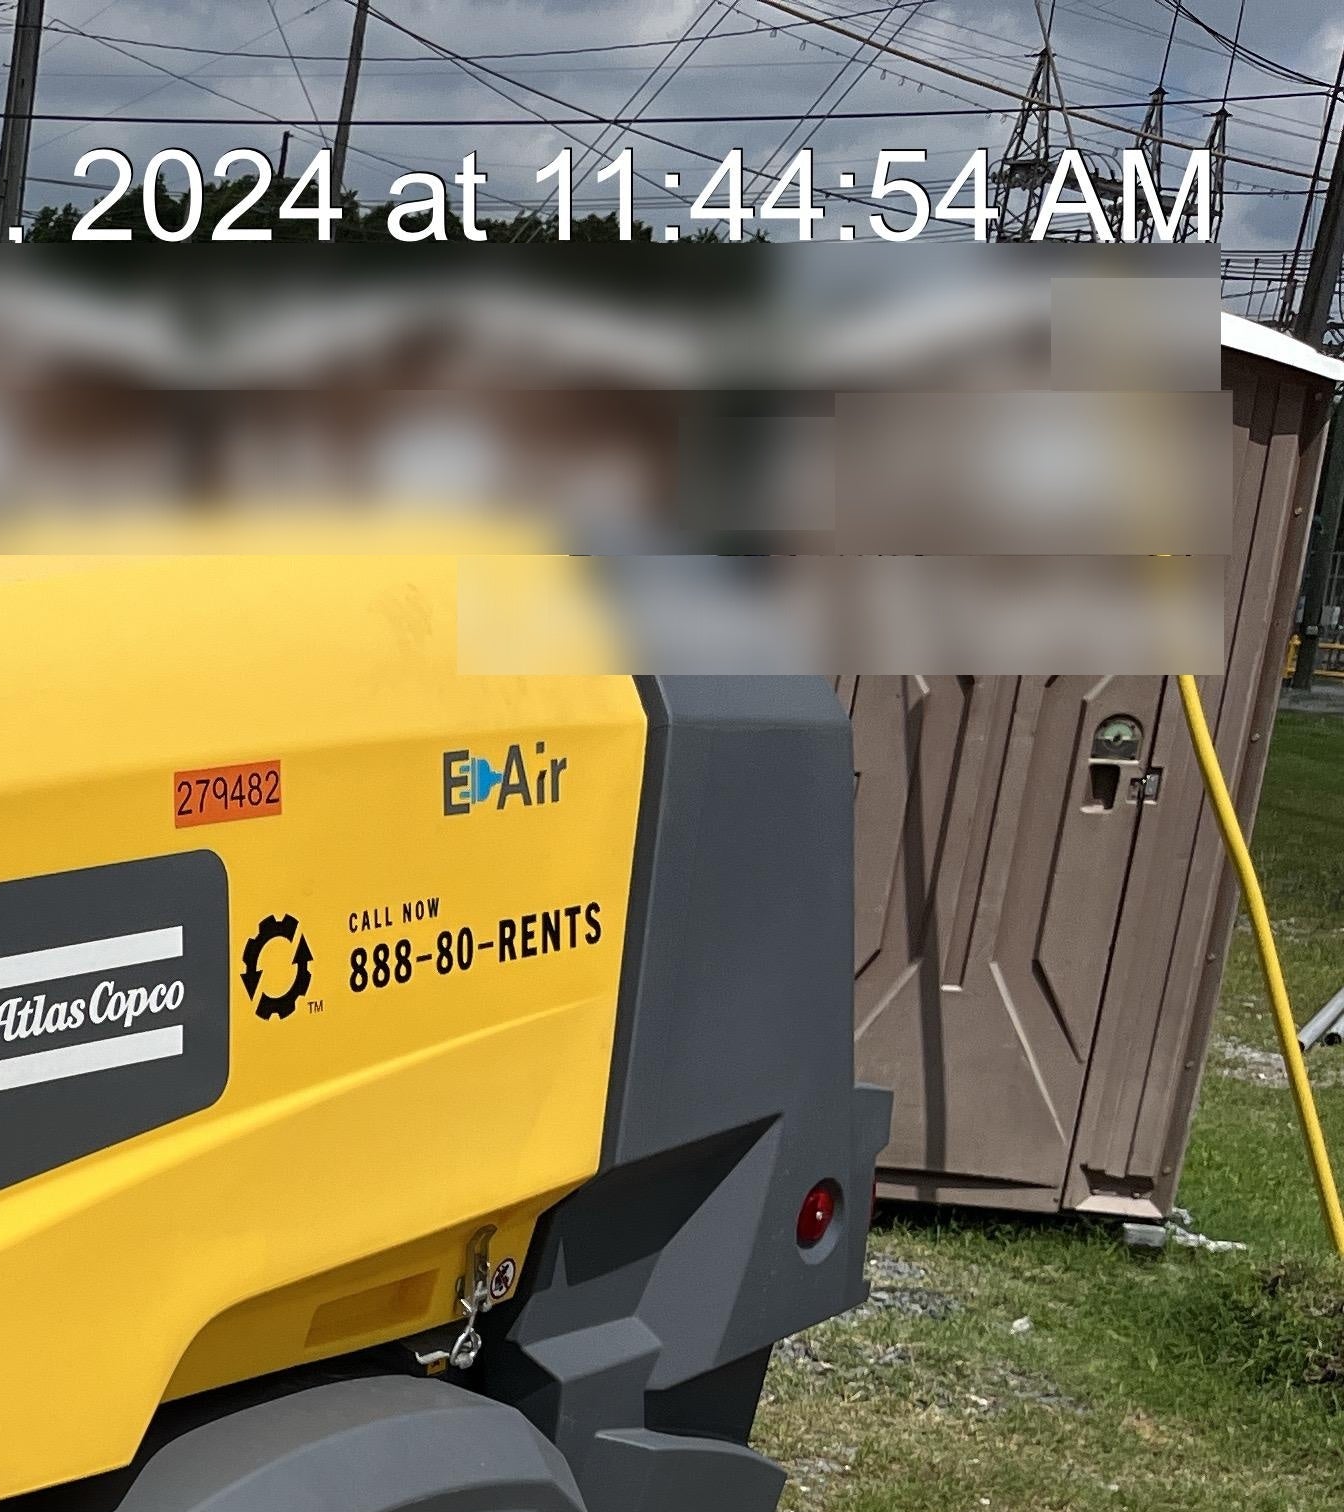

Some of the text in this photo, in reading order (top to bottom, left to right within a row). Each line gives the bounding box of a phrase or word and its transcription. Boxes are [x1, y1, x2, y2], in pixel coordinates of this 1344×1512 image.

[177, 769, 280, 816] 279482
[348, 896, 440, 934] CALL NOW
[348, 900, 602, 994] 888-80-RENTS
